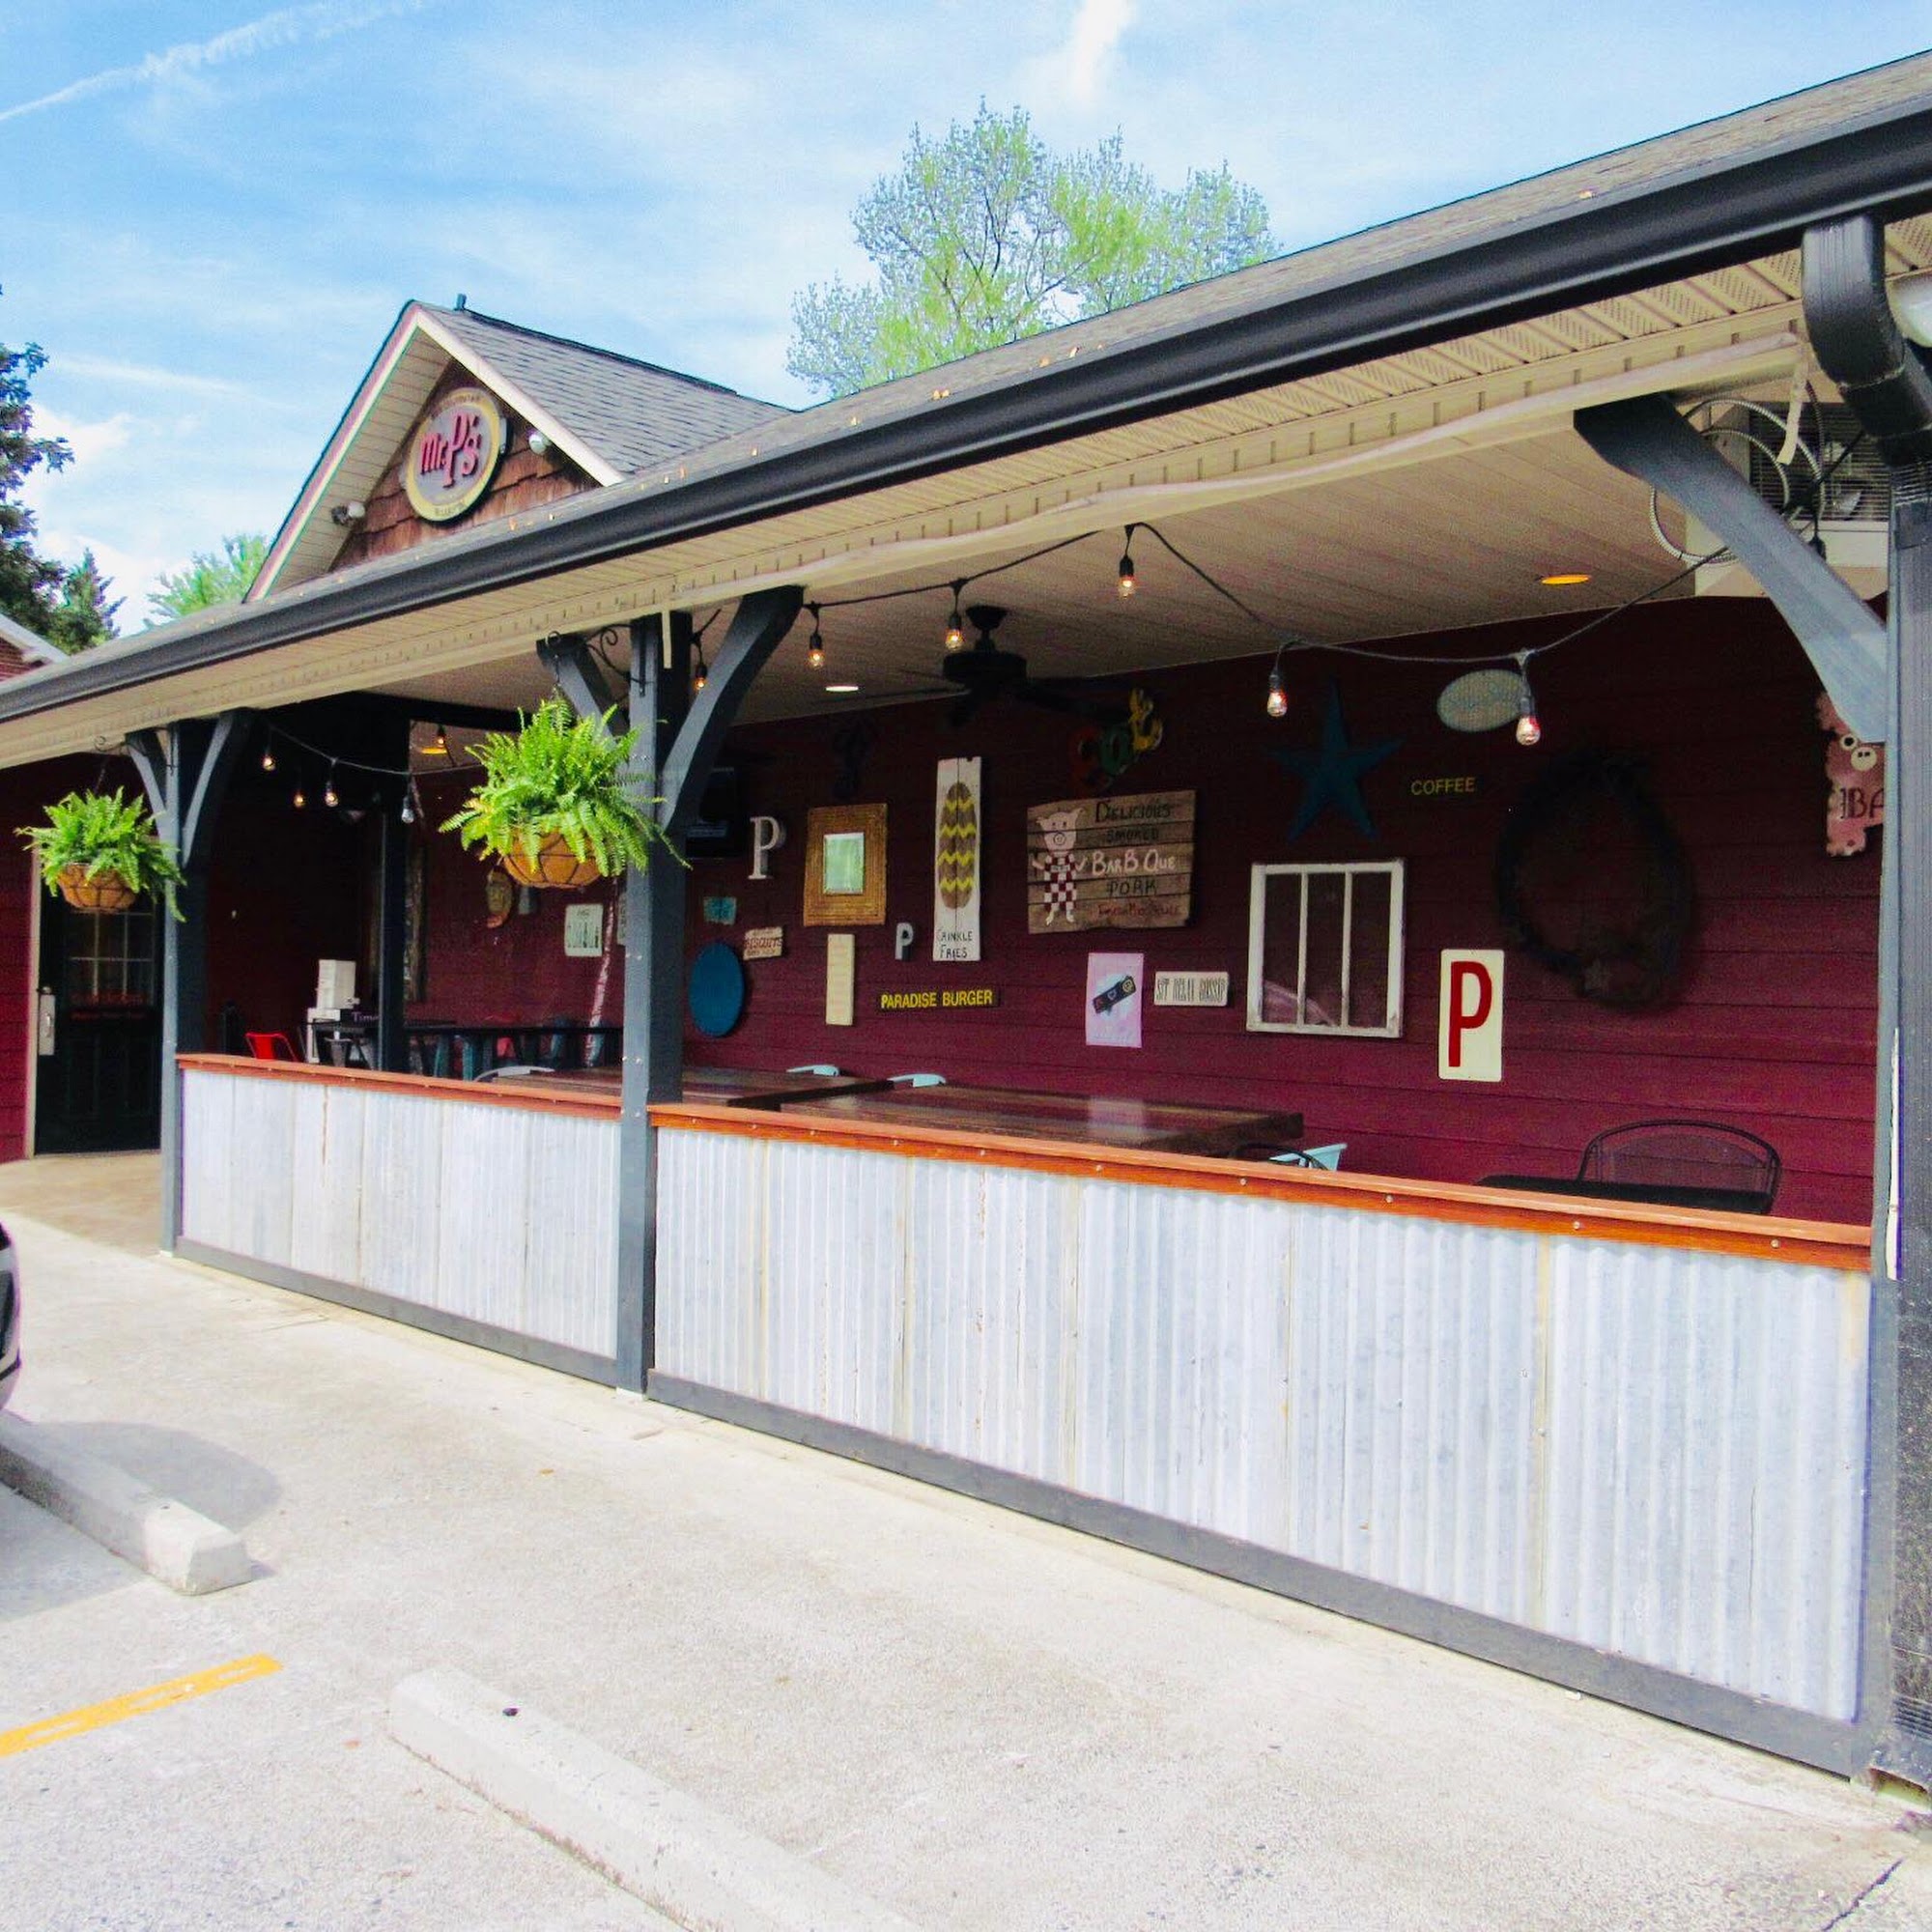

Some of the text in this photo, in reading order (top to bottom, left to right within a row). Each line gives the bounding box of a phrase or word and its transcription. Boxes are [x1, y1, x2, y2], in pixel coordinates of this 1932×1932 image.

[1410, 777, 1476, 796] COFFEE
[747, 815, 786, 880] P
[895, 923, 914, 960] P
[881, 989, 993, 1009] PARADISE BURGER
[1448, 961, 1492, 1067] P
